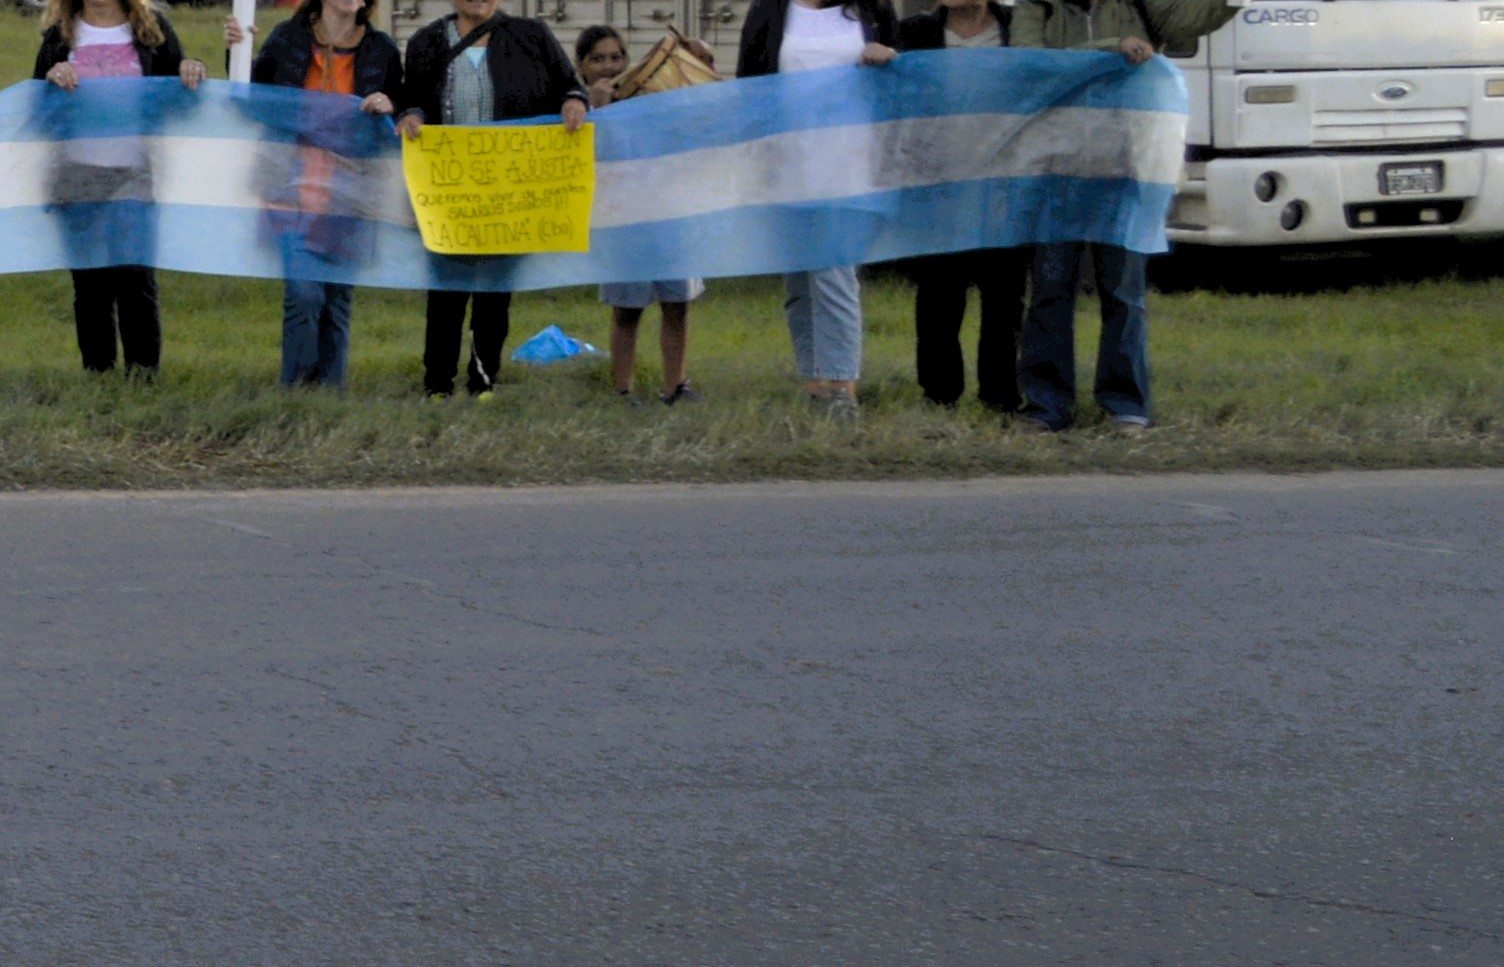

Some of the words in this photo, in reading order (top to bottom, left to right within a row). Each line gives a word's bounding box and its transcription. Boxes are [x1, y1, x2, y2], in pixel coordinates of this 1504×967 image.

[1244, 8, 1320, 24] CARGO
[420, 131, 456, 156] LA
[430, 159, 464, 182] NO
[469, 159, 498, 183] SE
[505, 155, 587, 183] AJUSTA
